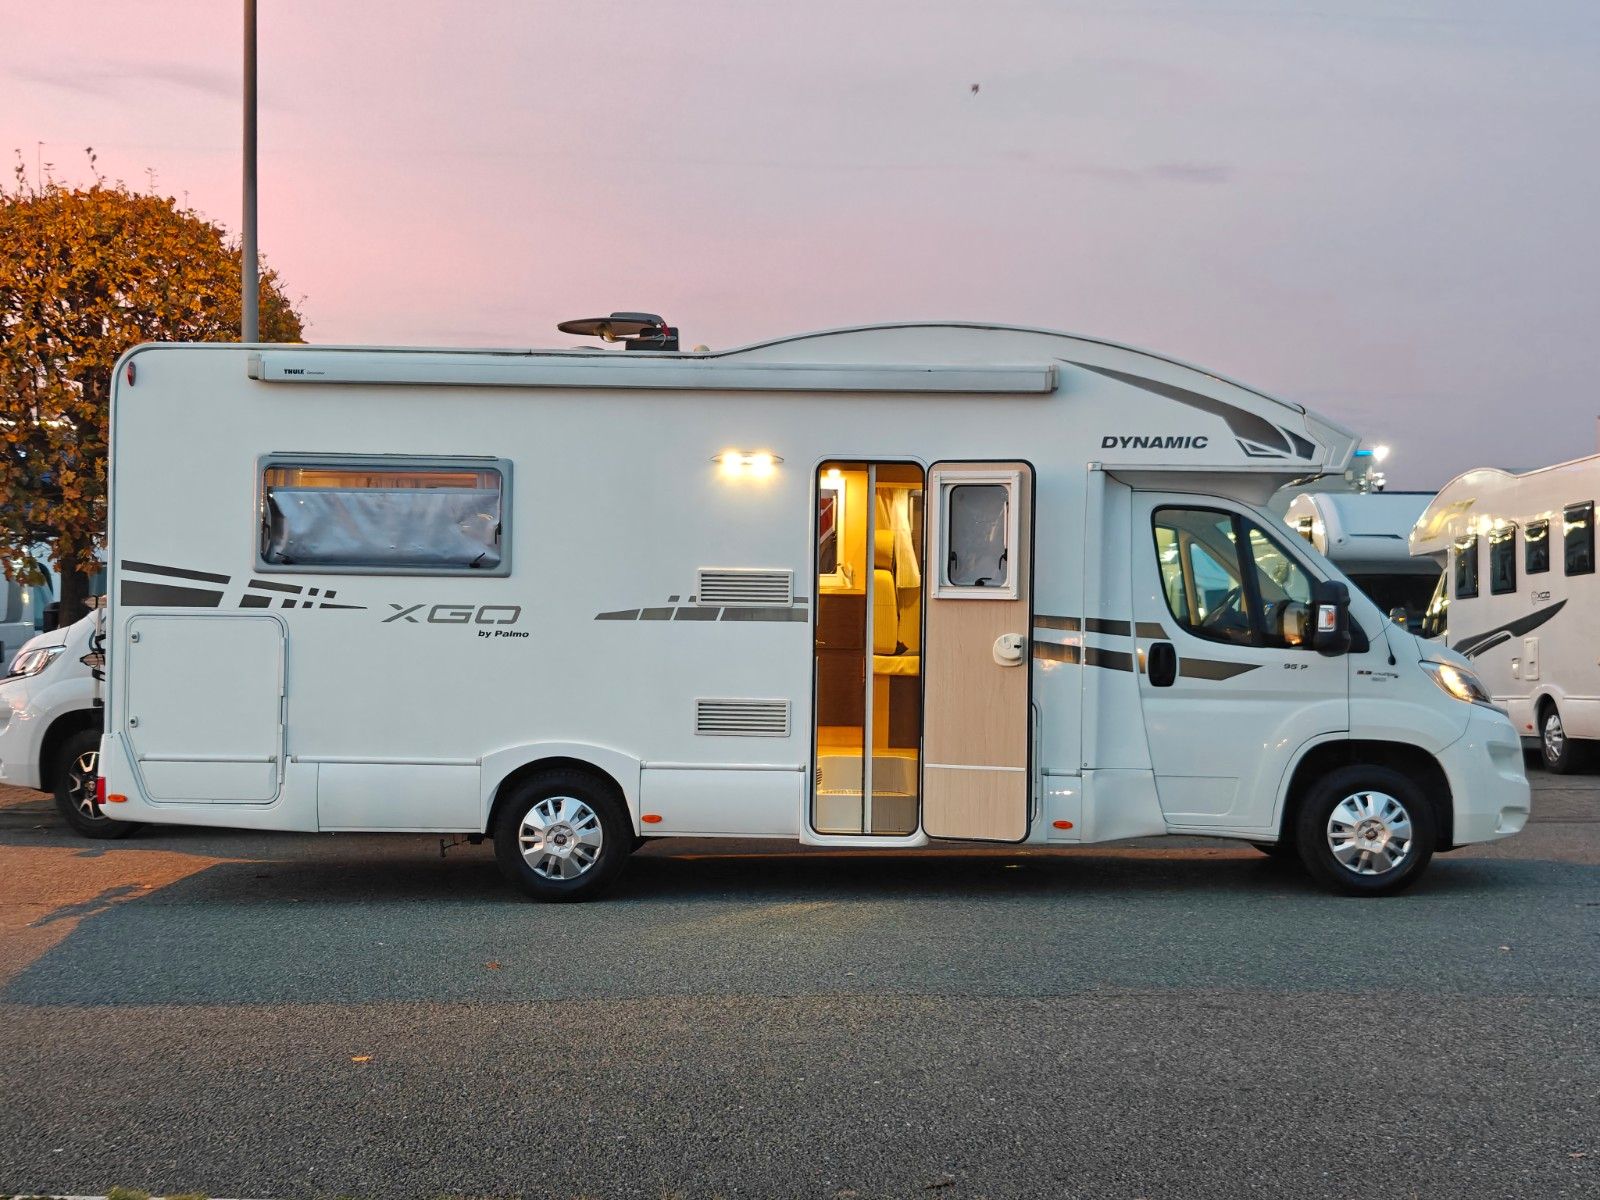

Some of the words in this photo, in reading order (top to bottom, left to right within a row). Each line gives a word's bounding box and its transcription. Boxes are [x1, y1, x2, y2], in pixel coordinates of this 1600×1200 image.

[1101, 436, 1209, 449] DYNAMIC
[381, 603, 522, 625] XGO
[478, 630, 492, 639] by
[494, 630, 530, 638] Palmo
